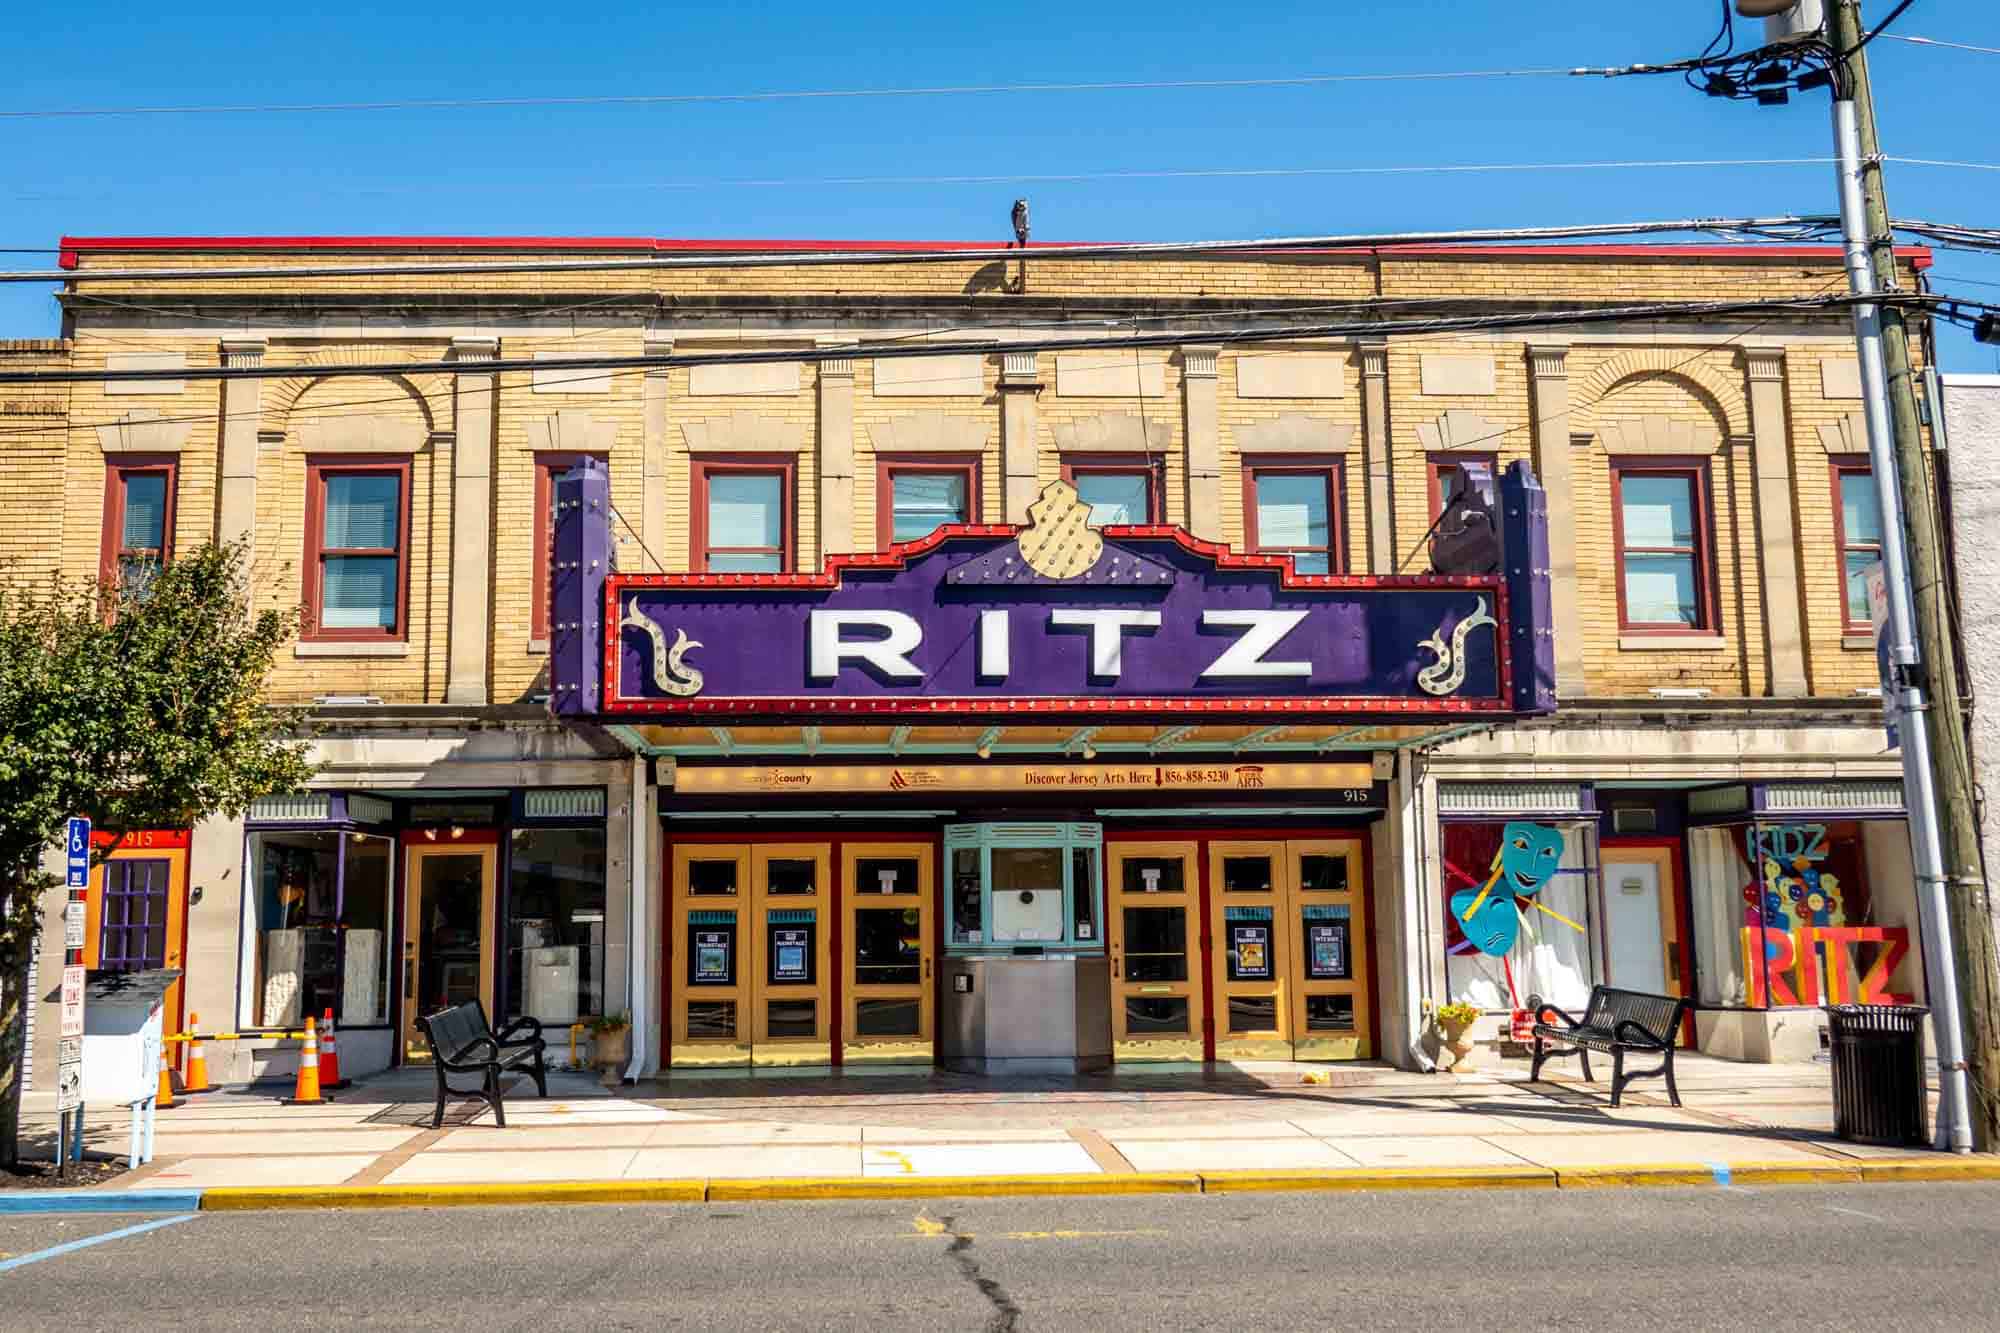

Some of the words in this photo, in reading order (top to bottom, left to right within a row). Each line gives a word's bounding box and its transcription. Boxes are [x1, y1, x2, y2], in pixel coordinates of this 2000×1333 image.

[808, 608, 1313, 678] RITZ
[779, 775, 812, 785] county
[1025, 772, 1066, 785] Discover
[1069, 771, 1097, 787] Jersey
[1103, 772, 1125, 784] Arts
[1129, 771, 1152, 784] Here
[1165, 770, 1229, 783] 856-858-5230
[1237, 777, 1264, 788] ARTS
[1343, 790, 1368, 802] 915
[126, 831, 153, 847] 915
[1746, 824, 1829, 862] KIDZ
[1740, 927, 1915, 1007] RITZ
